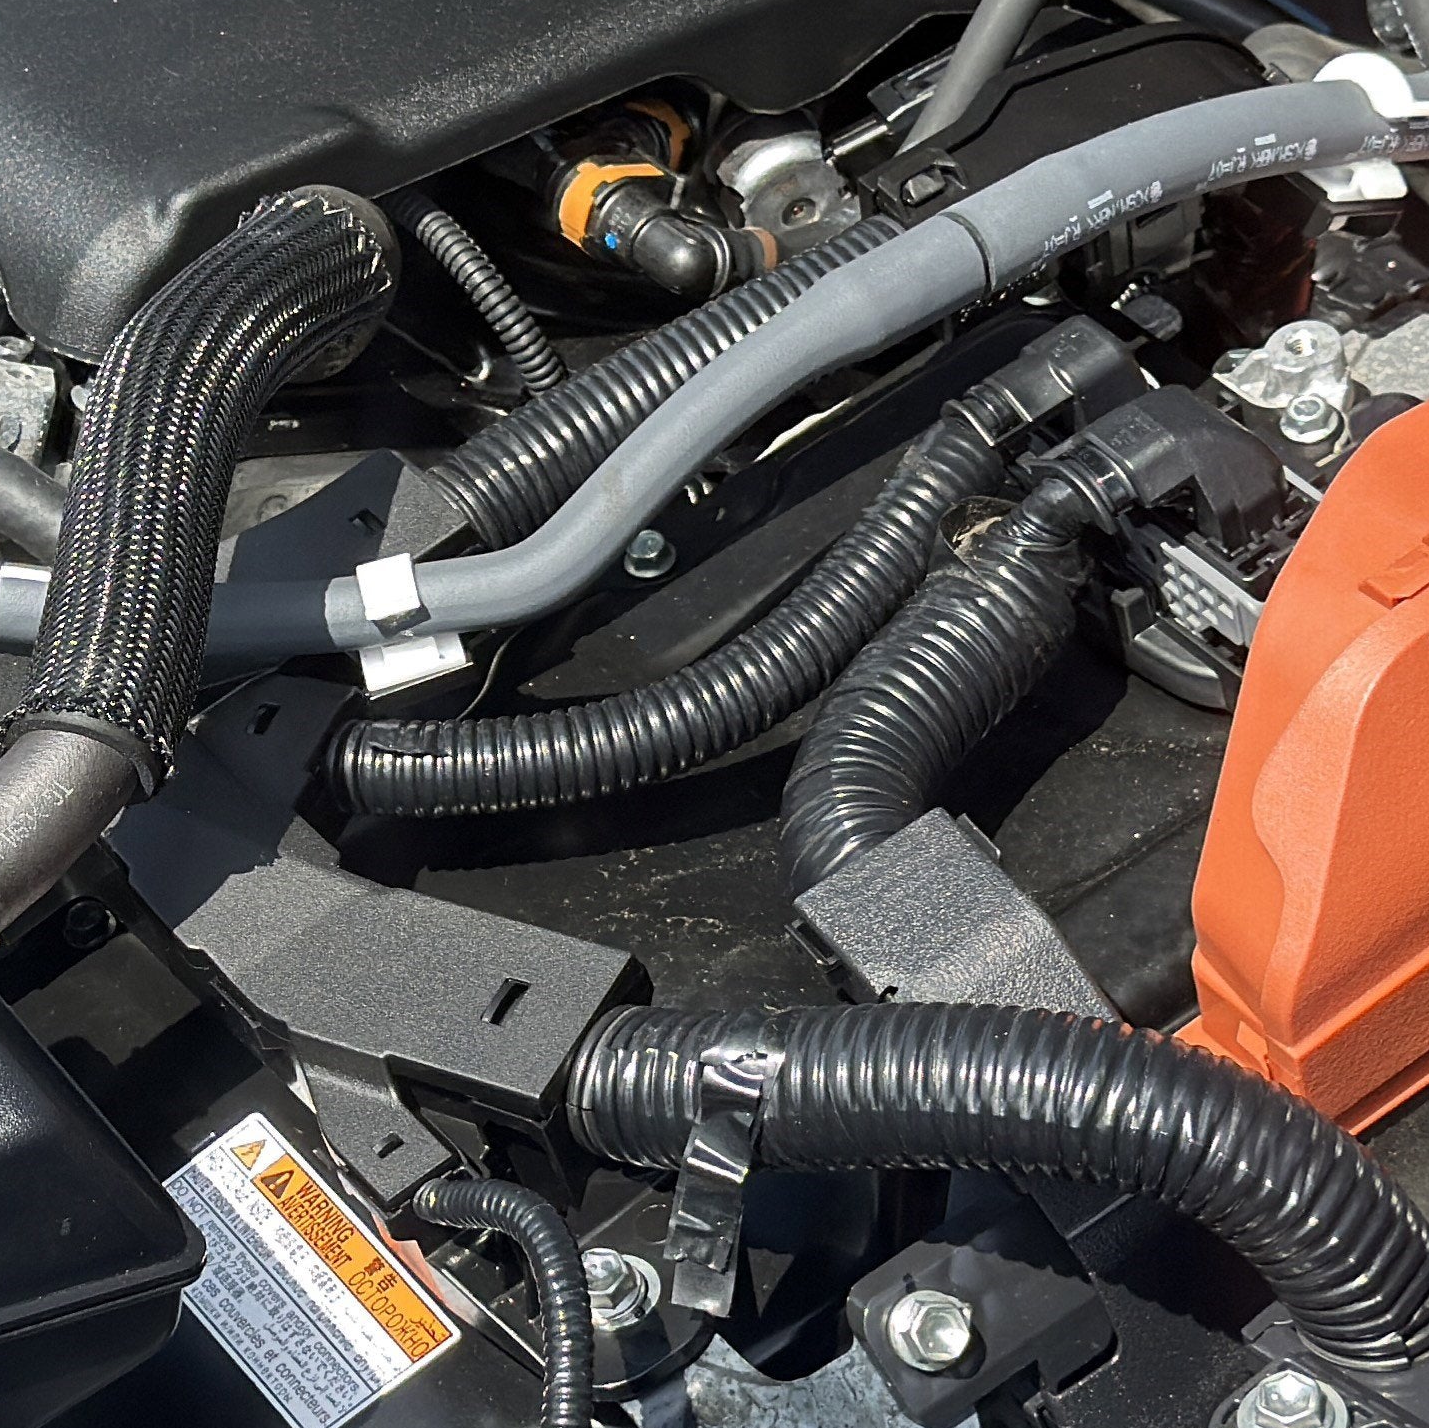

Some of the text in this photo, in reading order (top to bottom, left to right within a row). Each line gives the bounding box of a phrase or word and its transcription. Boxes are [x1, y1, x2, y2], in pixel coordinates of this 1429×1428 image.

[277, 1193, 351, 1269] AVERTISSEMENT
[298, 1181, 354, 1244] WARNING
[171, 1178, 189, 1197] DO
[185, 1195, 208, 1219] NOT
[204, 1217, 237, 1252] remove
[234, 1250, 260, 1278] these
[257, 1276, 287, 1309] covers
[285, 1308, 315, 1341] and/or
[200, 1276, 333, 1424] ces couvercles et connecteurs.
[347, 1269, 431, 1360] ОСТОРОЖНО
